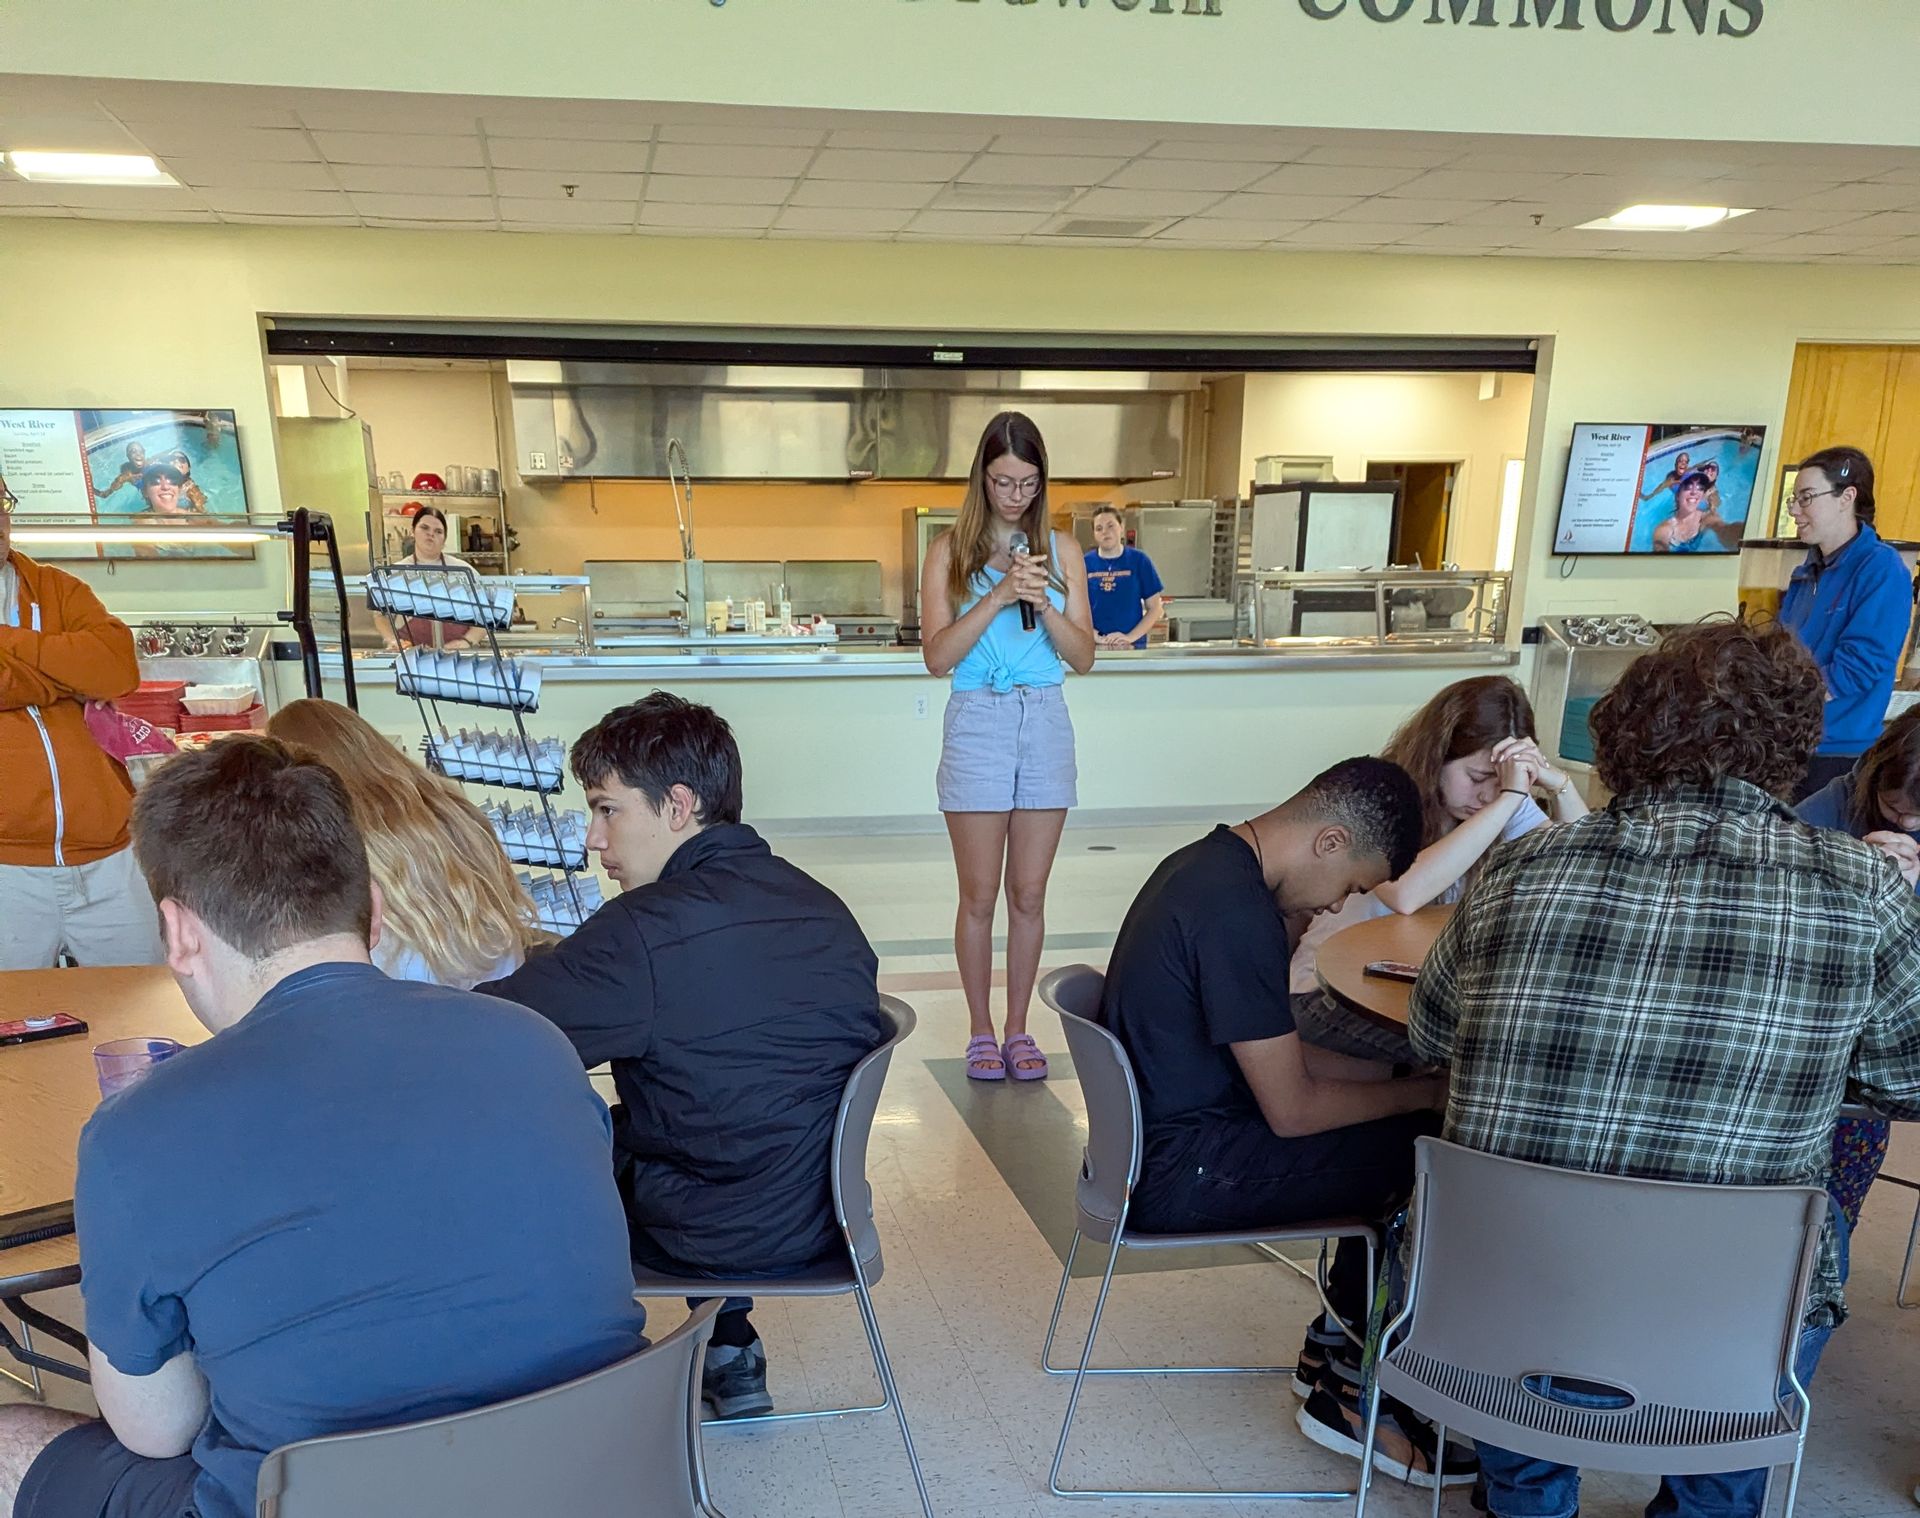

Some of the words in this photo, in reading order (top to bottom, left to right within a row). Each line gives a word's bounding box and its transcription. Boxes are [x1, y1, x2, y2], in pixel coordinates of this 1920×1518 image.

[28, 420, 56, 429] River
[1591, 433, 1609, 441] West
[1610, 433, 1632, 441] River
[132, 725, 151, 744] CITY
